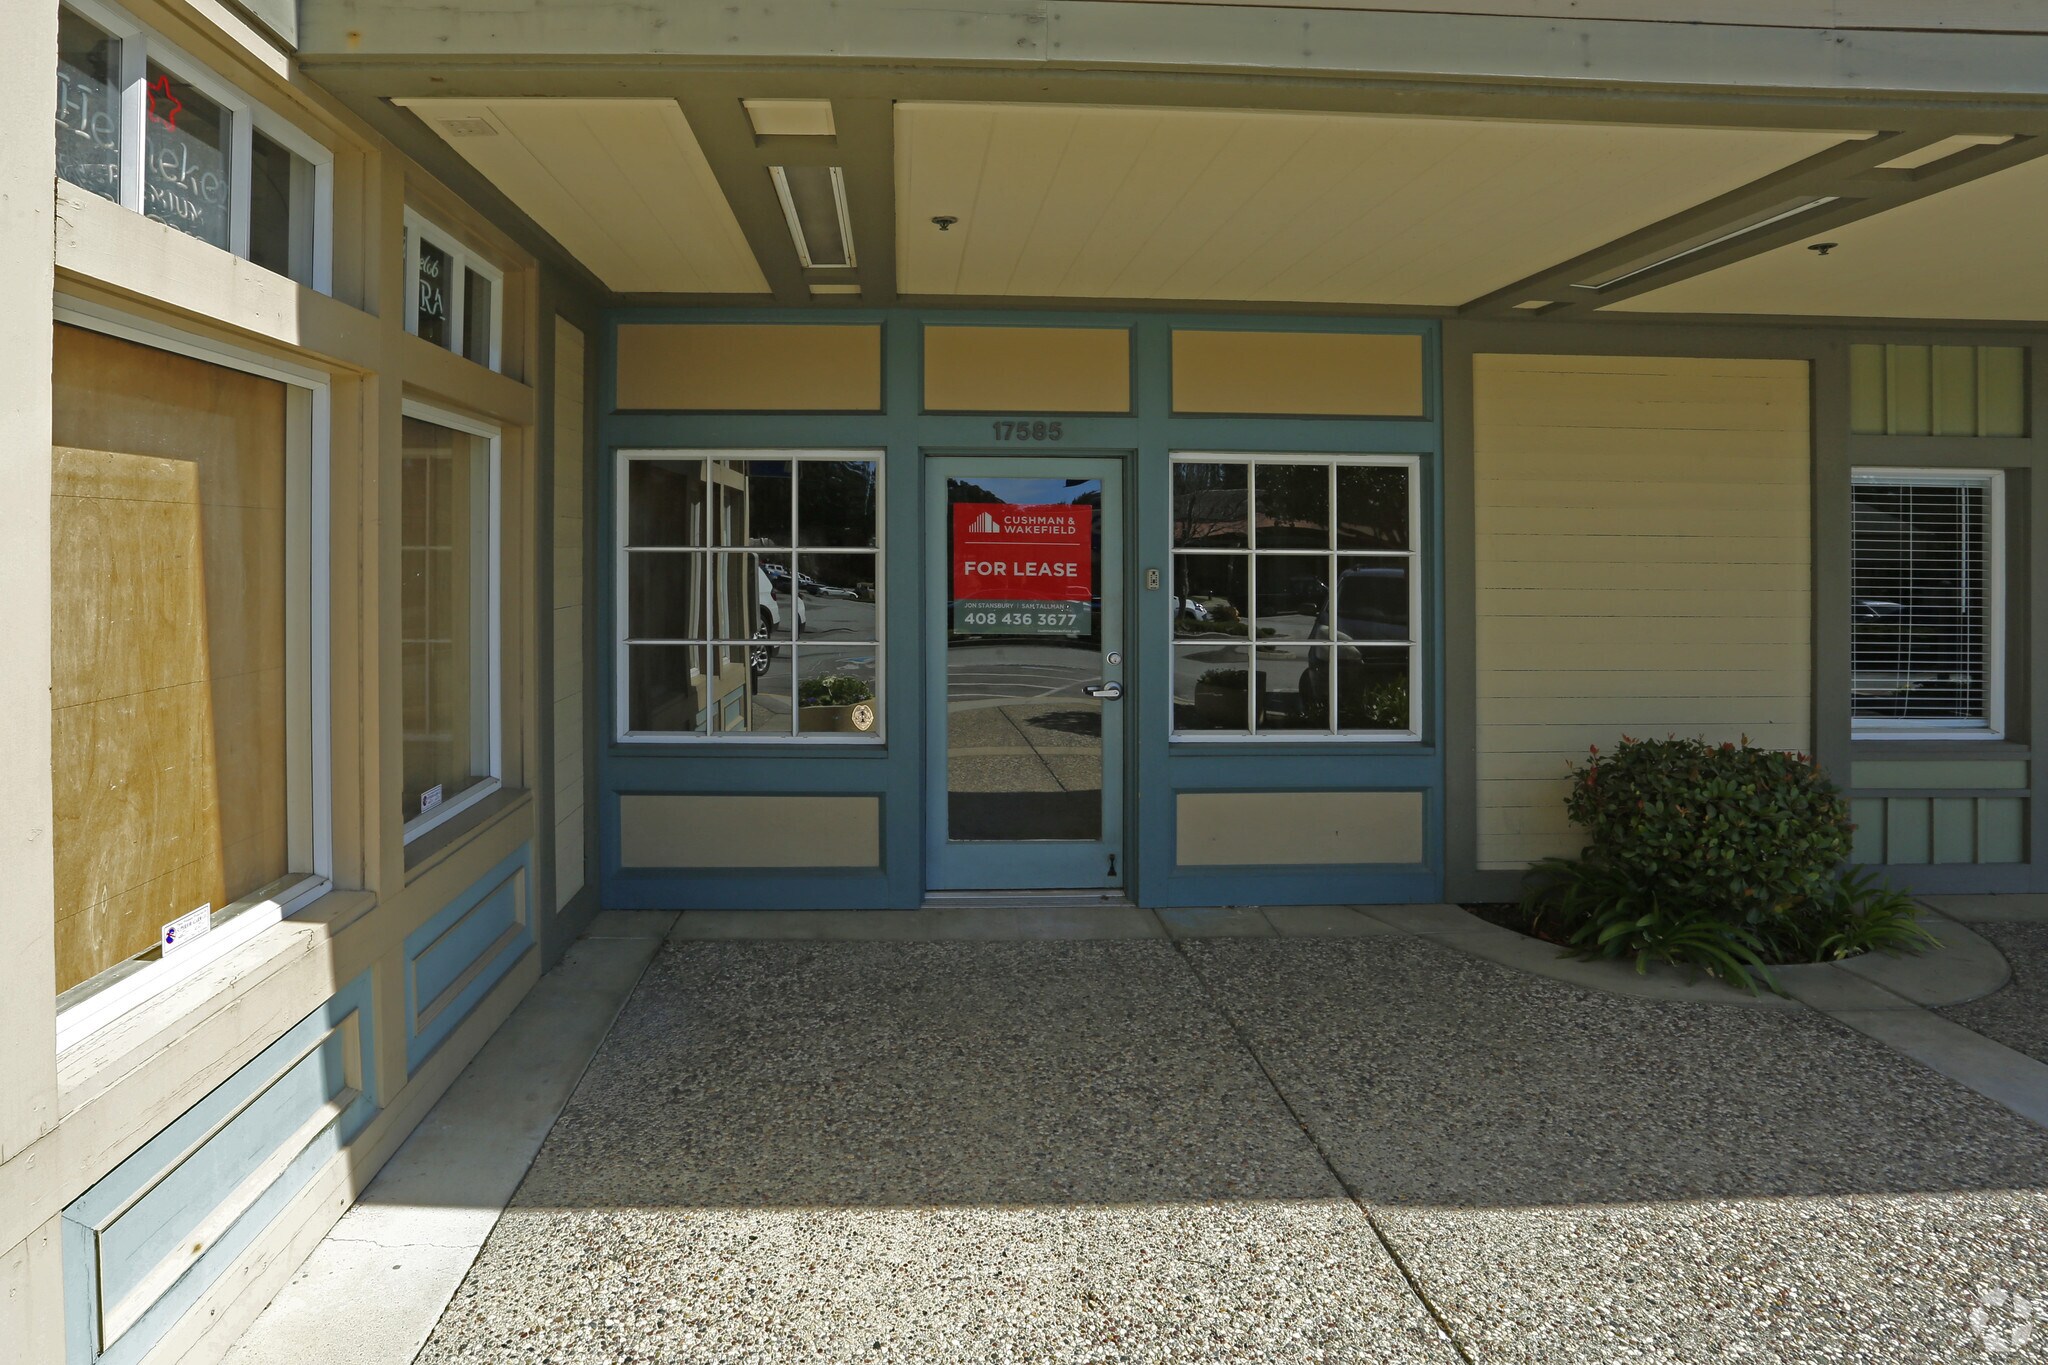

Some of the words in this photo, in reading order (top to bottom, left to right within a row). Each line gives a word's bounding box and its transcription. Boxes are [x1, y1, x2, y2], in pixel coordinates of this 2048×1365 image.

[993, 421, 1063, 441] 17585
[1004, 516, 1064, 525] CUSHMAN
[1067, 516, 1075, 525] &
[1004, 525, 1076, 535] WAKEFIELD
[964, 561, 1007, 576] FOR
[1013, 562, 1078, 577] LEASE
[964, 612, 997, 625] 408
[1001, 613, 1032, 625] 436
[1037, 613, 1077, 626] 3677
